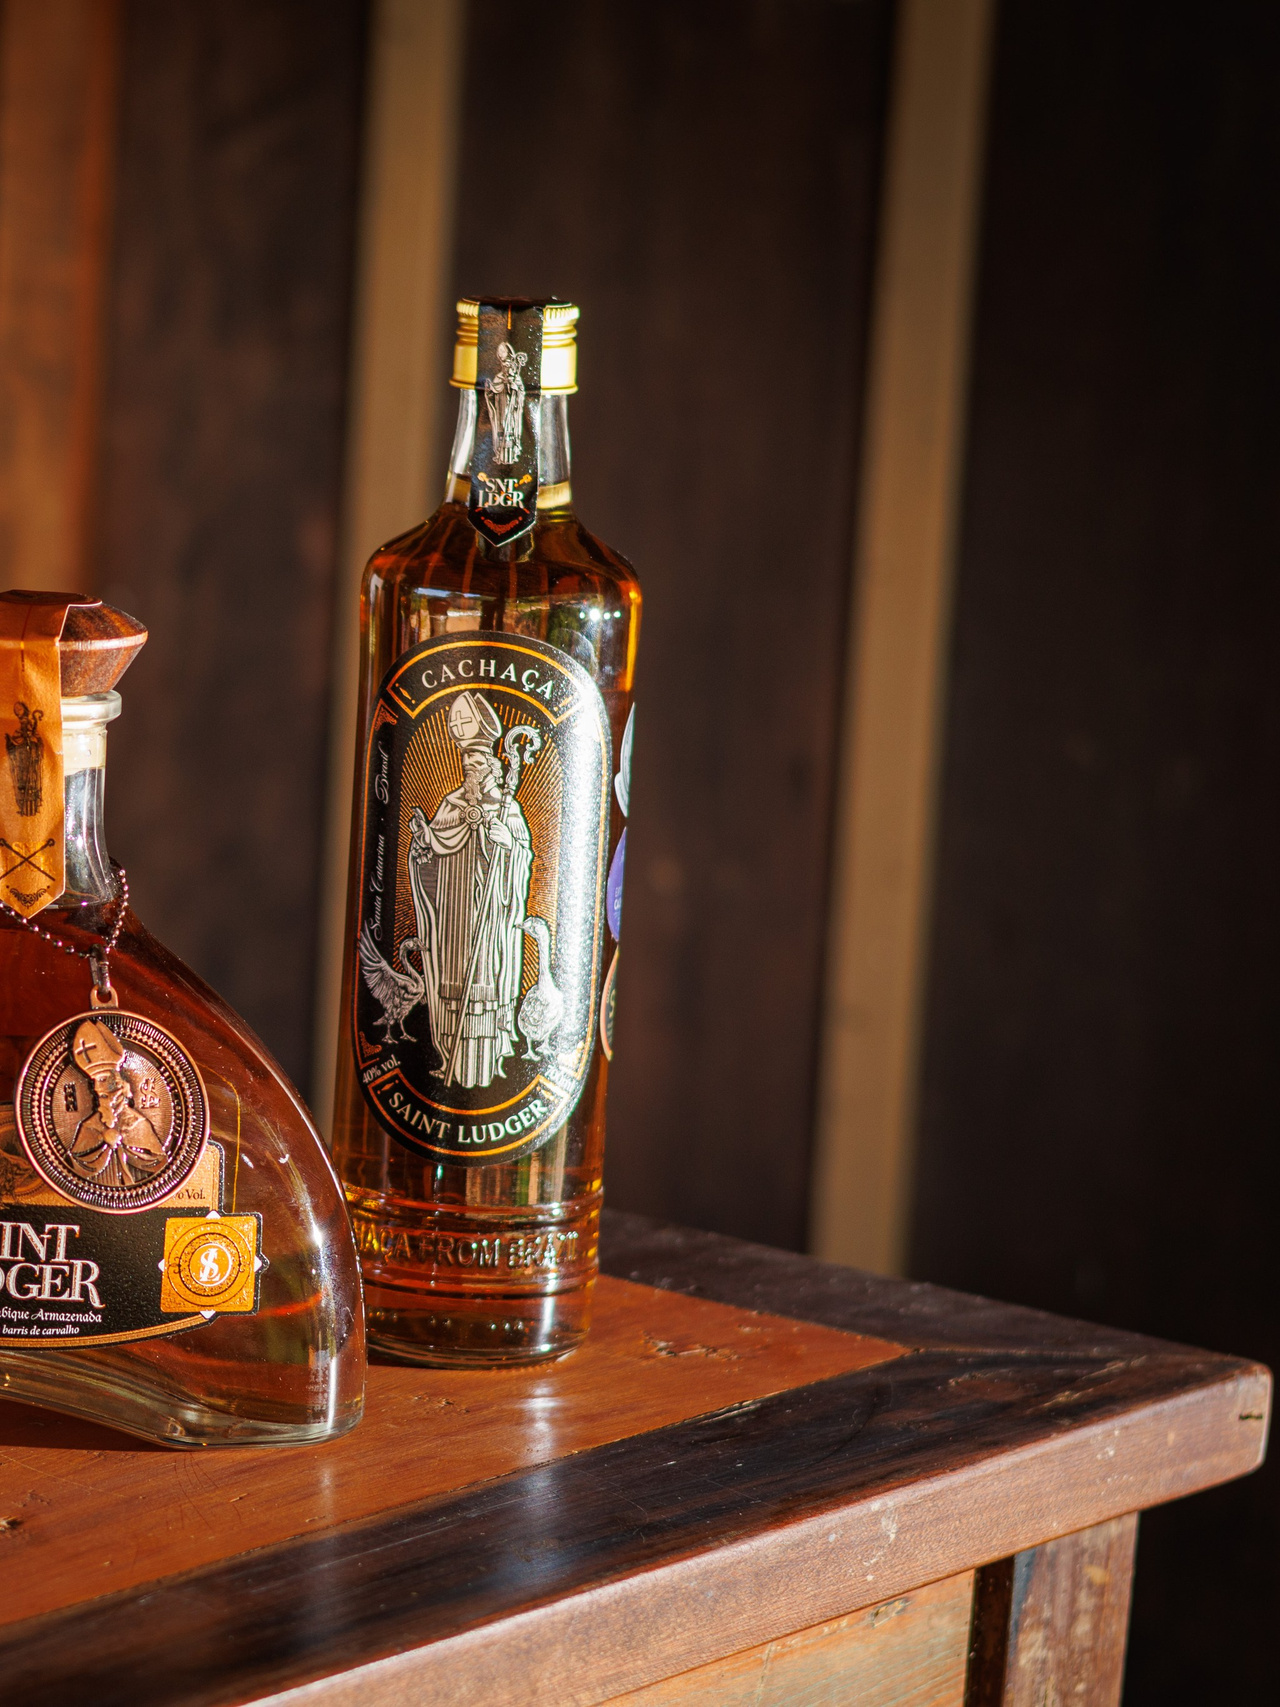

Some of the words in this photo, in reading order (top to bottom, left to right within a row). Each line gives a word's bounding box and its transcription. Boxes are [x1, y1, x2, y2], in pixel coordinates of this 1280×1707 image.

[477, 490, 524, 509] LDGR
[485, 478, 518, 493] SNT
[421, 659, 554, 700] CACHAÇA
[375, 741, 389, 804] Brasil
[370, 835, 385, 892] Catarina
[370, 895, 383, 941] Santa
[361, 1065, 381, 1085] 40%
[381, 1054, 401, 1072] vol.
[389, 1092, 451, 1139] SAINT
[458, 1099, 549, 1144] LUDGER
[185, 1189, 206, 1200] Vol.
[419, 1232, 500, 1268] FROM
[2, 1325, 28, 1335] barris
[30, 1325, 41, 1335] de
[42, 1325, 80, 1335] carvalho
[30, 1308, 102, 1323] Armazenada
